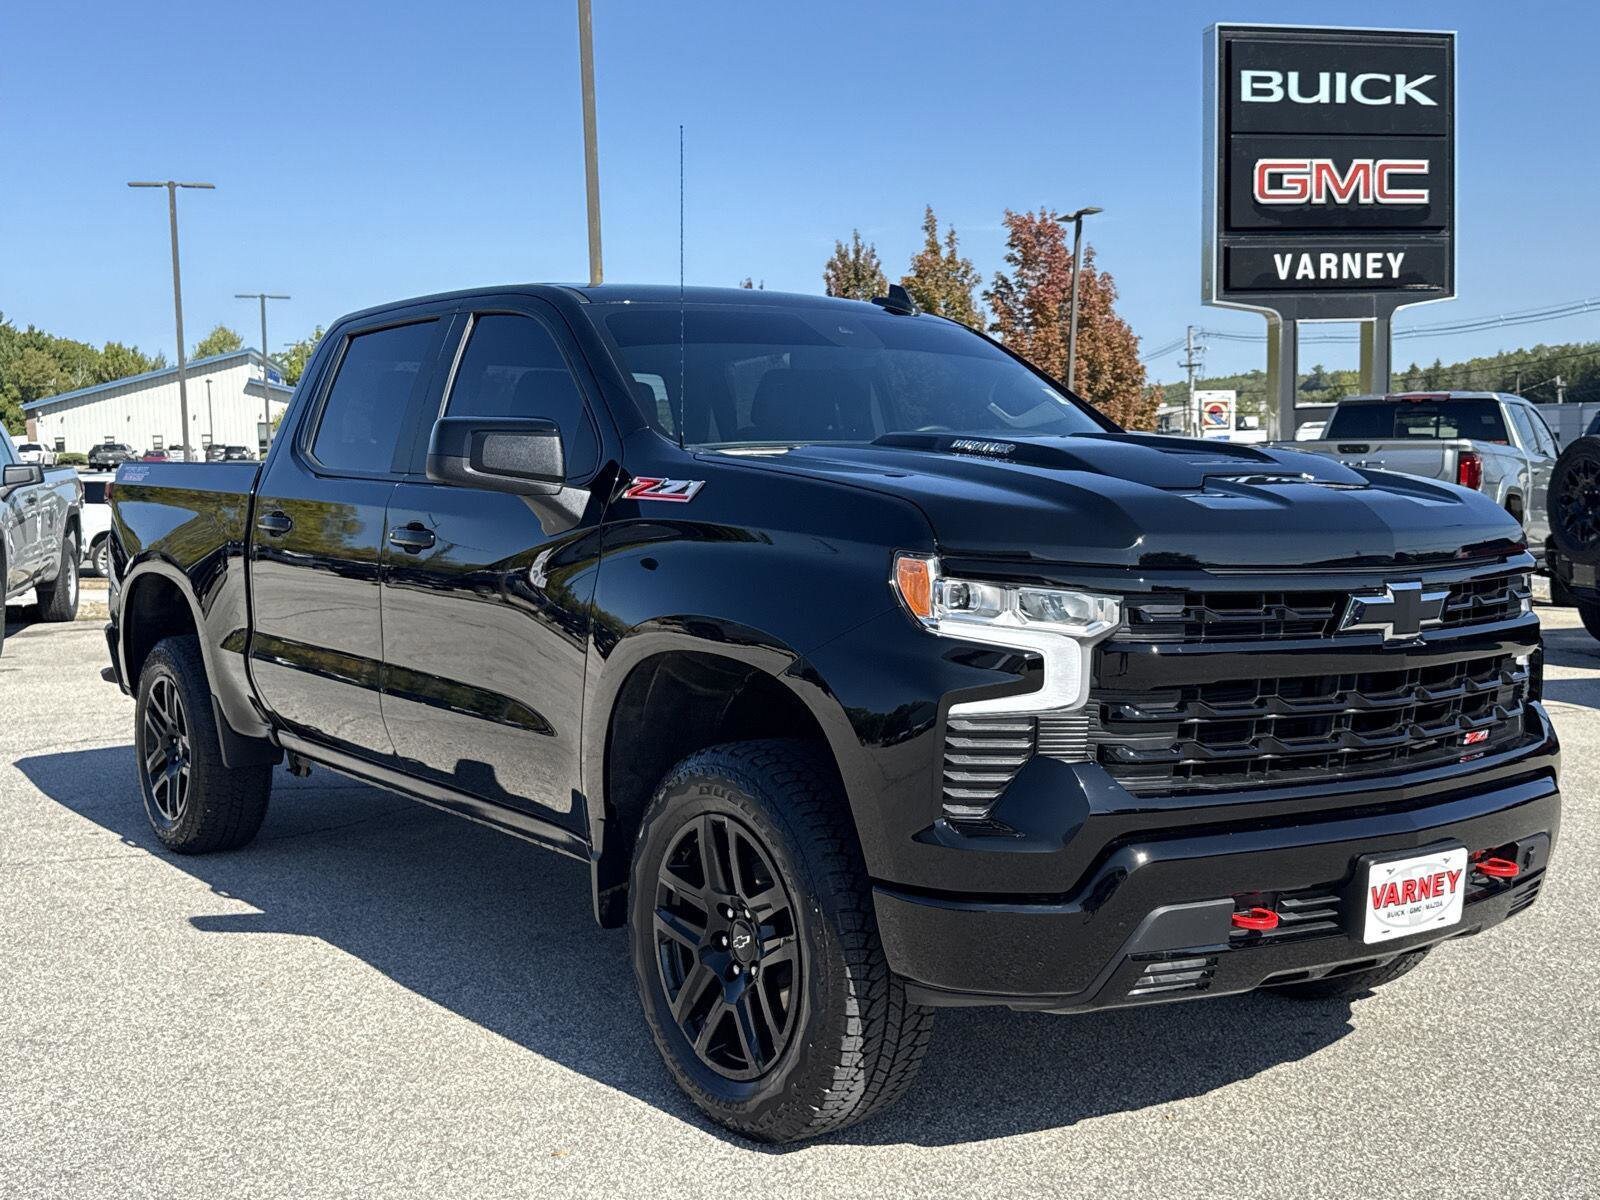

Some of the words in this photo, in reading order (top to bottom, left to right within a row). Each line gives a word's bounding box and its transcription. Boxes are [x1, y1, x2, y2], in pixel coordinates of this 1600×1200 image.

[1240, 70, 1438, 106] BUICK
[1253, 158, 1430, 205] GMC
[1273, 252, 1405, 280] VARNEY
[621, 476, 706, 503] Z71
[1371, 869, 1462, 910] VARNEY
